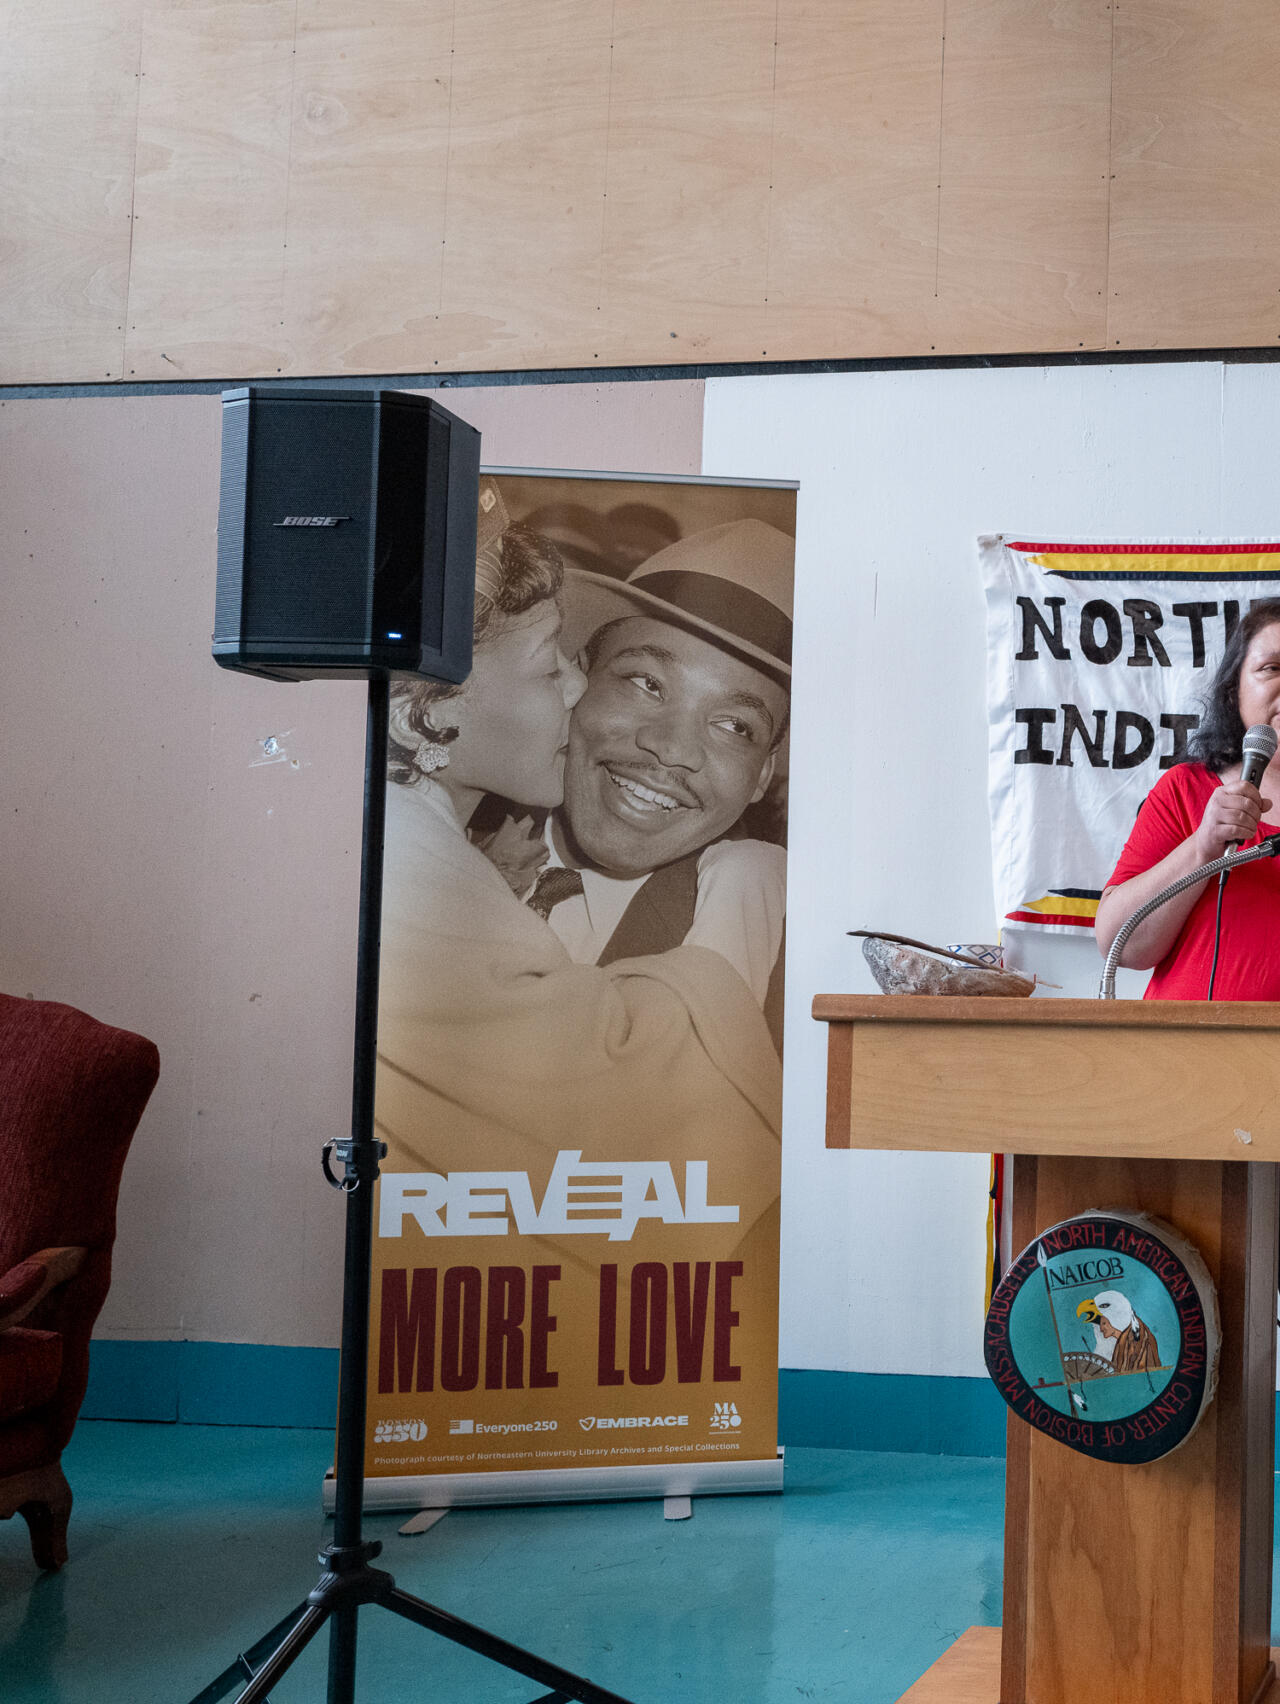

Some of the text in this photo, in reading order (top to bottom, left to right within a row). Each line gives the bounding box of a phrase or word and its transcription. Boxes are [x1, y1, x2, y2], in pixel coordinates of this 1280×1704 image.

[273, 516, 350, 527] BOSE
[1014, 703, 1201, 770] INDI
[379, 1150, 740, 1241] REVEAL
[1042, 1224, 1106, 1254] NORTH
[1050, 1257, 1124, 1287] NAICOB
[1112, 1228, 1193, 1301] AMERICAN
[378, 1260, 743, 1394] MORE LOVE
[1179, 1307, 1206, 1378] INDIAN
[597, 1416, 689, 1429] EMBRACE
[709, 1415, 742, 1430] 250
[714, 1402, 738, 1415] MA
[1023, 1398, 1094, 1447] BOSTON
[1127, 1381, 1192, 1442] CENTER
[475, 1421, 558, 1435] Everyone250
[1102, 1424, 1126, 1447] OF
[374, 1456, 425, 1465] Photograph
[427, 1454, 464, 1463] courtesy
[478, 1450, 533, 1460] Northeastern
[535, 1449, 577, 1458] University
[579, 1448, 608, 1457] Library
[611, 1446, 645, 1454] Archives
[665, 1444, 694, 1453] Special
[695, 1442, 740, 1451] Collections
